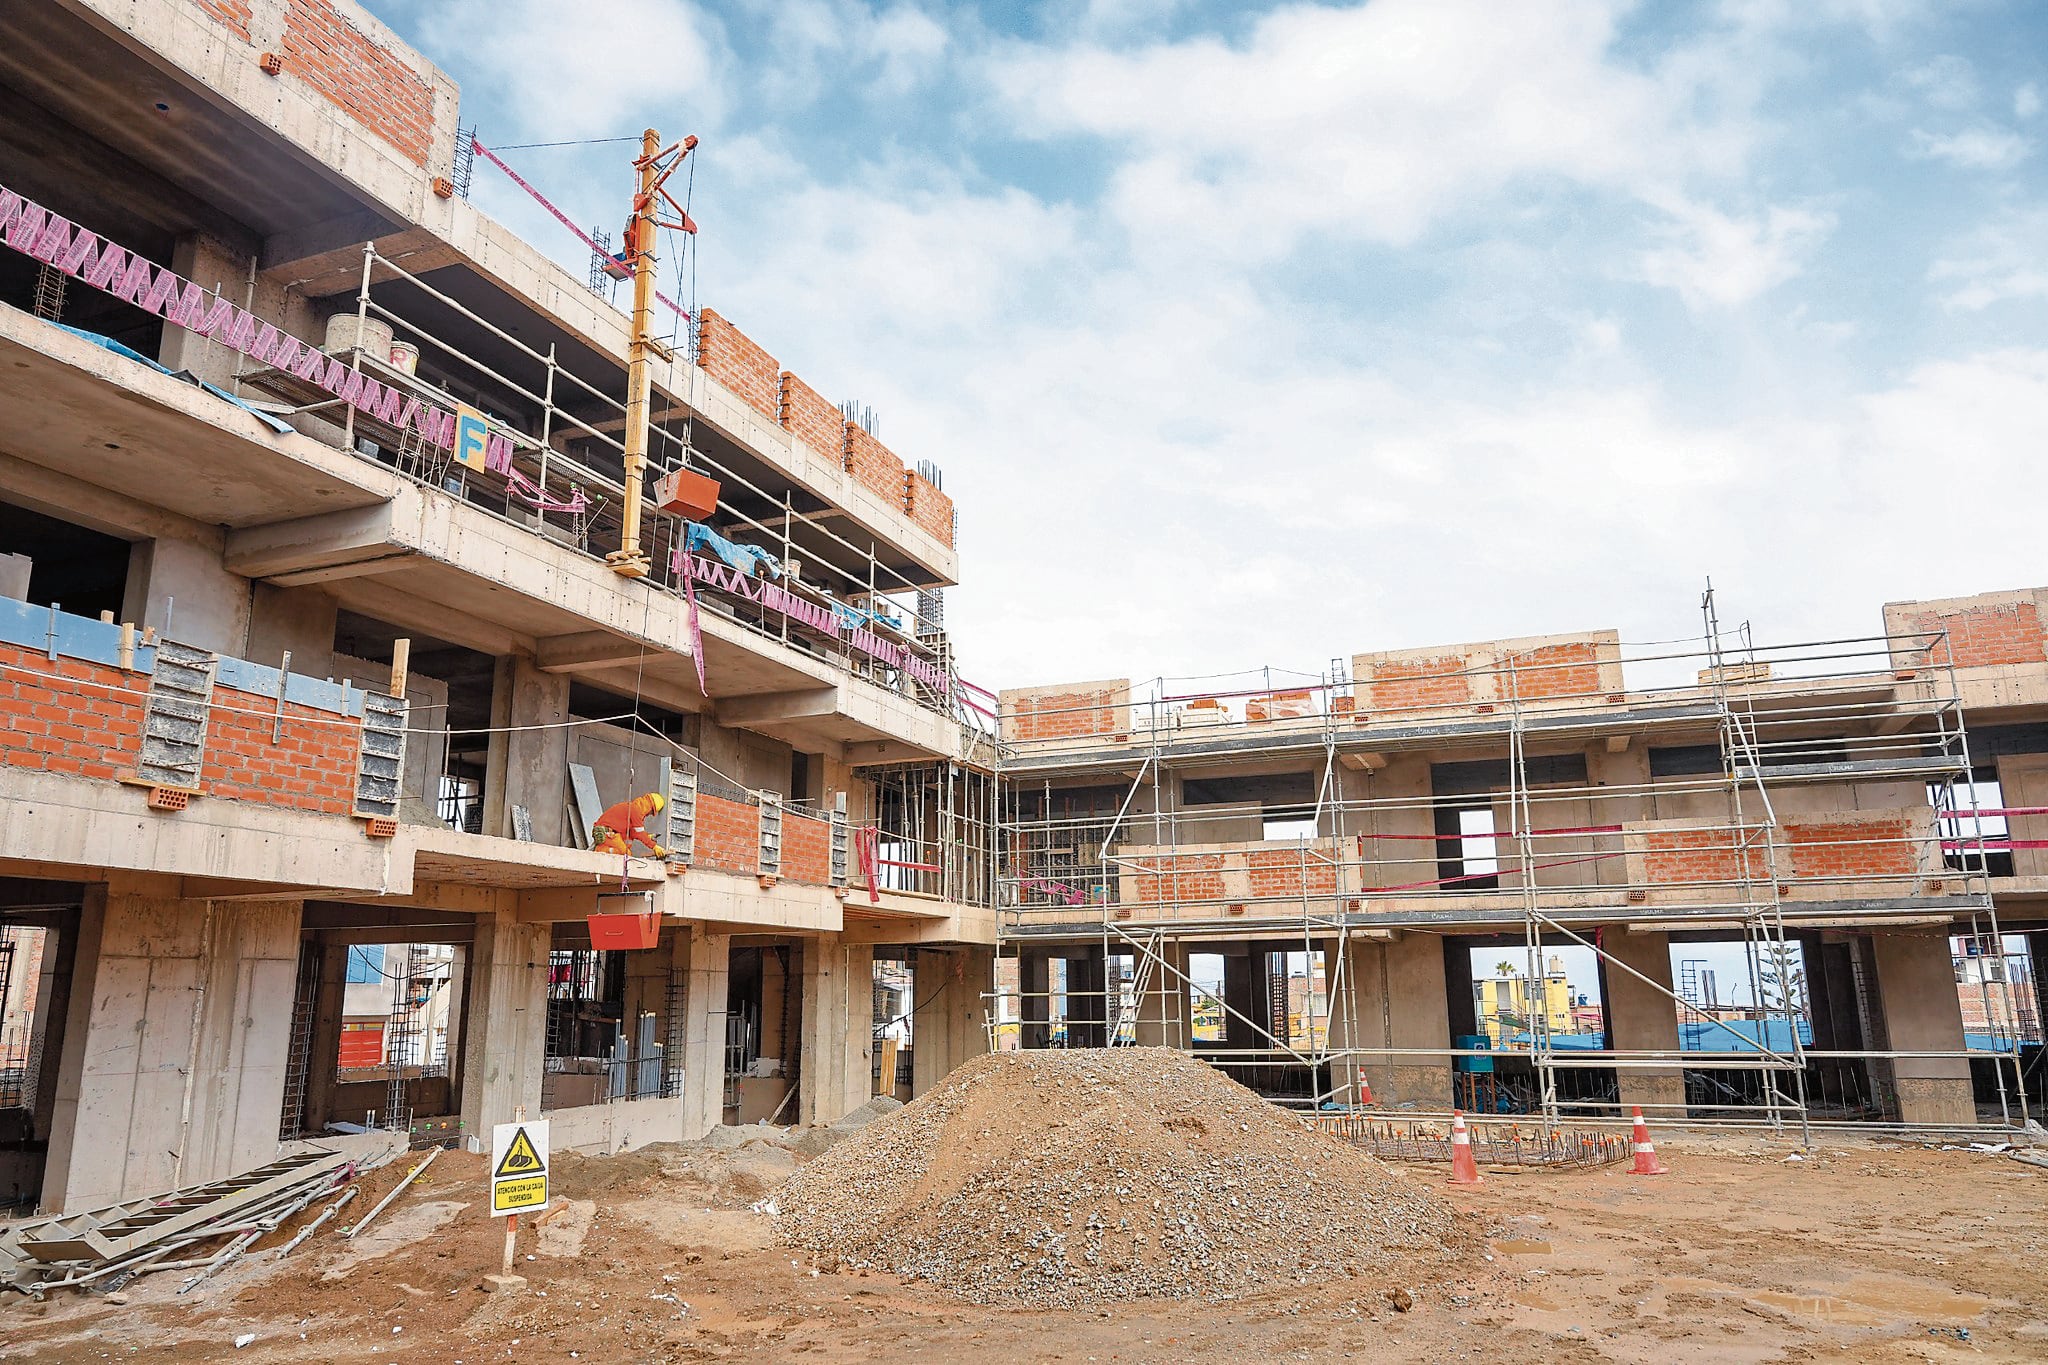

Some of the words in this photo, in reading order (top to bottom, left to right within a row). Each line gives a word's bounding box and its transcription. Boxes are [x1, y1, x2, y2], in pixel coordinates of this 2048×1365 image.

[460, 414, 487, 461] F
[517, 1184, 526, 1193] CON
[508, 1194, 532, 1203] SUSPENDIDA
